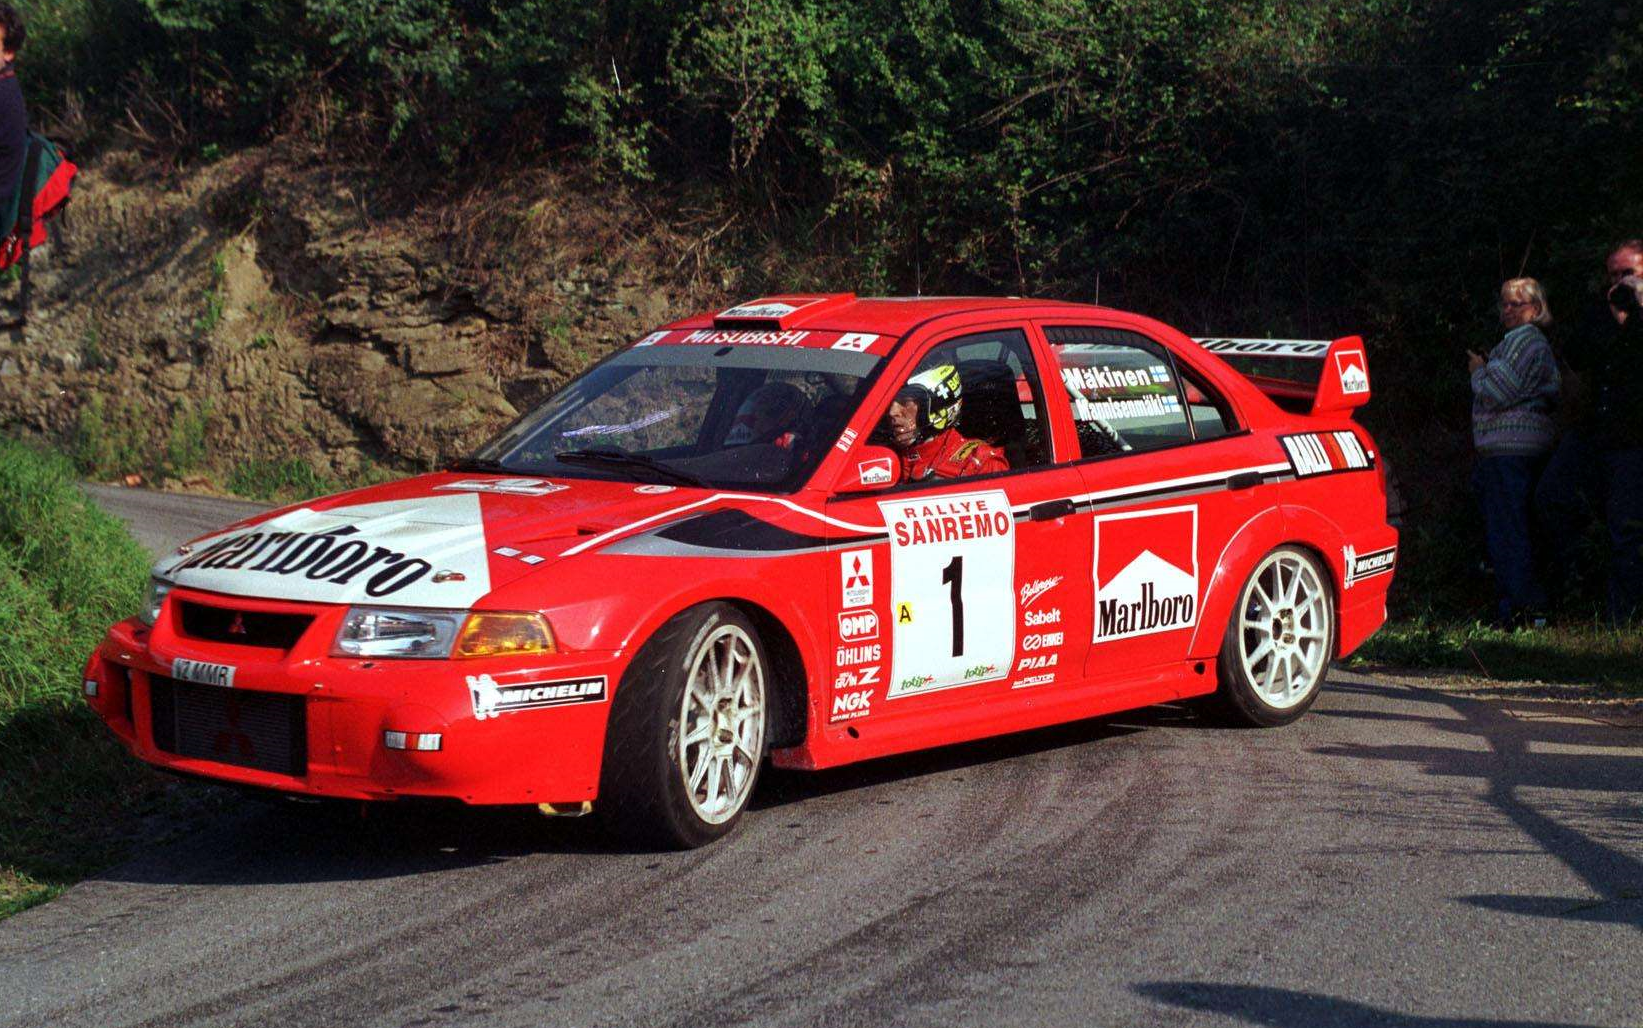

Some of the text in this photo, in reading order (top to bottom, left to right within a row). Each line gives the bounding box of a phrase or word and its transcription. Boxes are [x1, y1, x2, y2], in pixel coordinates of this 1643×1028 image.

[681, 329, 812, 347] MITSUBISHI
[1062, 366, 1152, 390] Mäkinen
[903, 500, 988, 518] RALLYE
[894, 511, 1010, 547] SANREMO
[164, 524, 432, 597] Marlboro
[1356, 551, 1395, 574] MICHELIN
[899, 604, 912, 623] A
[942, 555, 964, 658] 1
[1024, 607, 1061, 627] Sabelt
[1097, 581, 1194, 637] Marlboro
[841, 614, 877, 637] OMP
[836, 643, 881, 667] ÖHLINS
[1017, 653, 1058, 672] PIAA
[500, 681, 604, 705] MICHELIN
[832, 688, 875, 715] NGK
